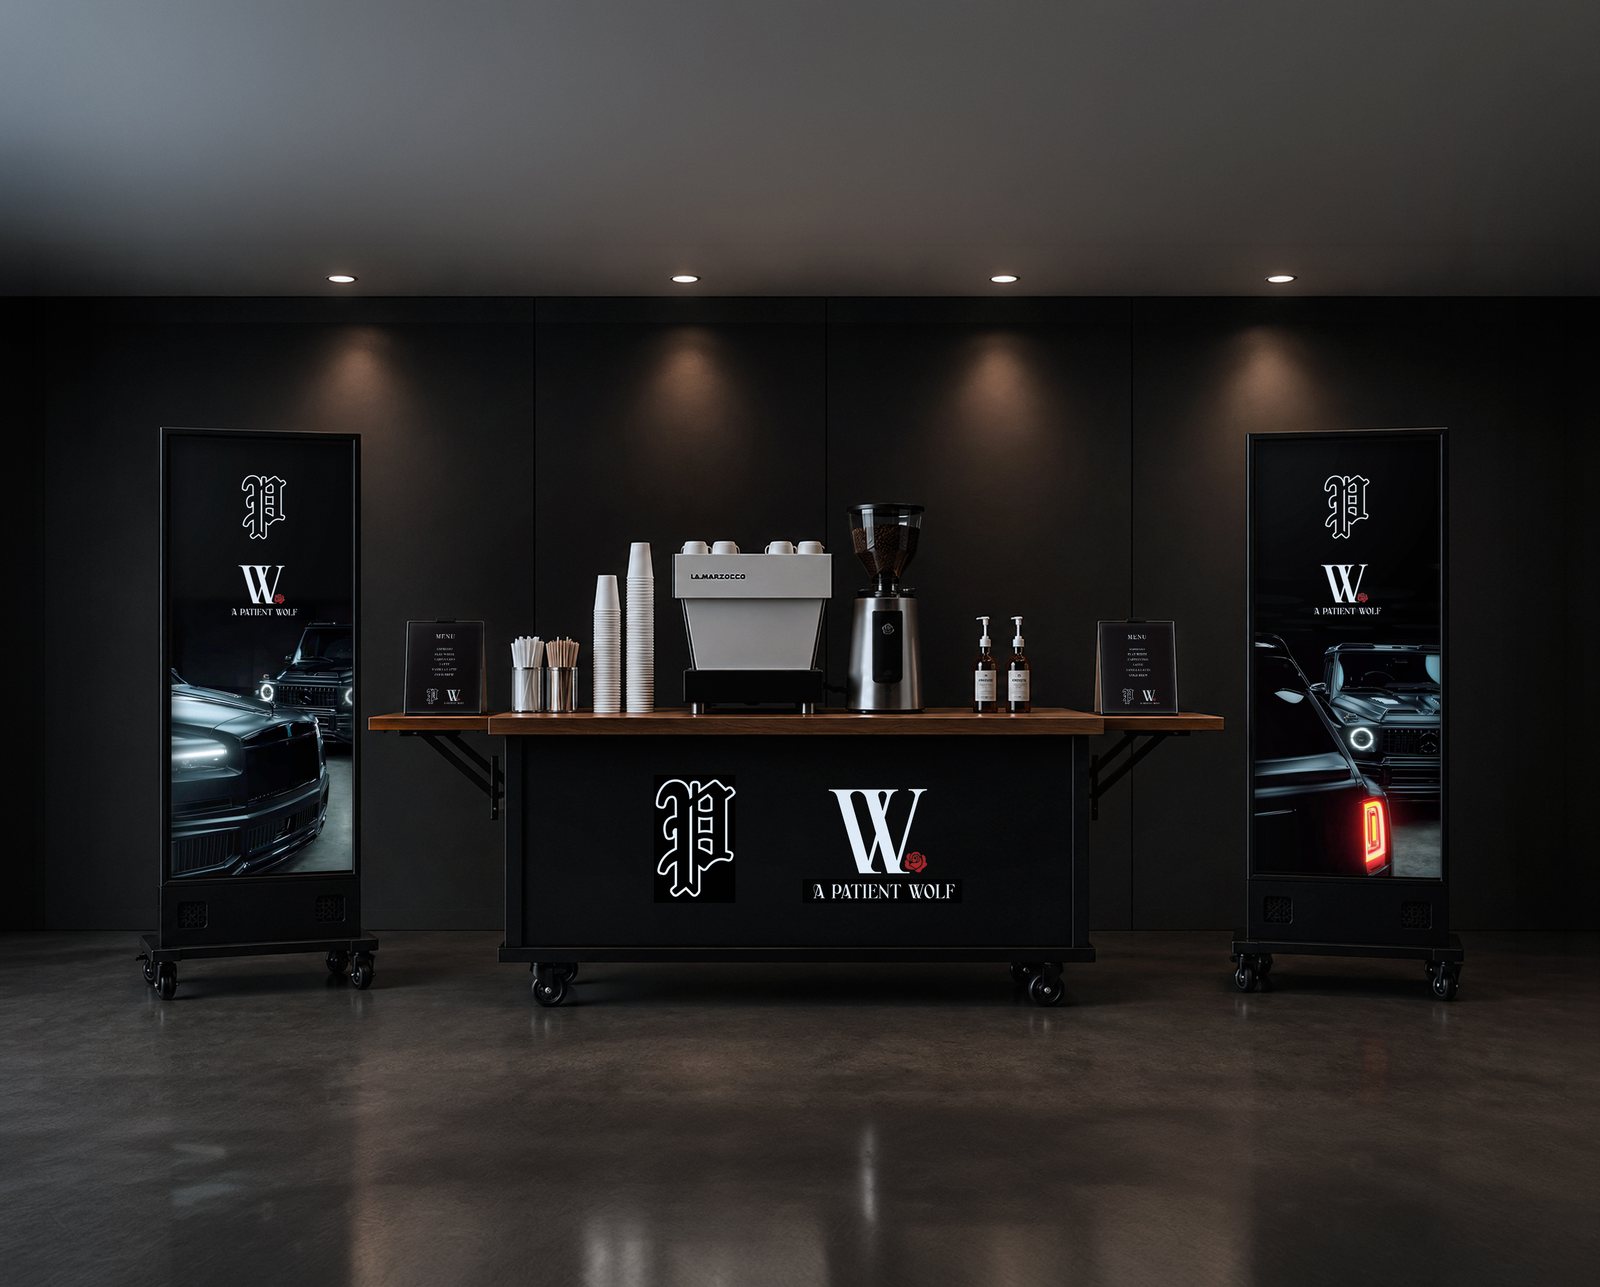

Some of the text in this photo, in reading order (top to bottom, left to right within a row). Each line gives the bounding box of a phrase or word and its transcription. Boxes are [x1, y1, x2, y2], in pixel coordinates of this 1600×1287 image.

[231, 608, 298, 616] A PATIENT WOLF
[1314, 607, 1382, 615] A PATIENT WOLF
[828, 788, 928, 874] W
[813, 884, 956, 900] A PATIENT WOLF
